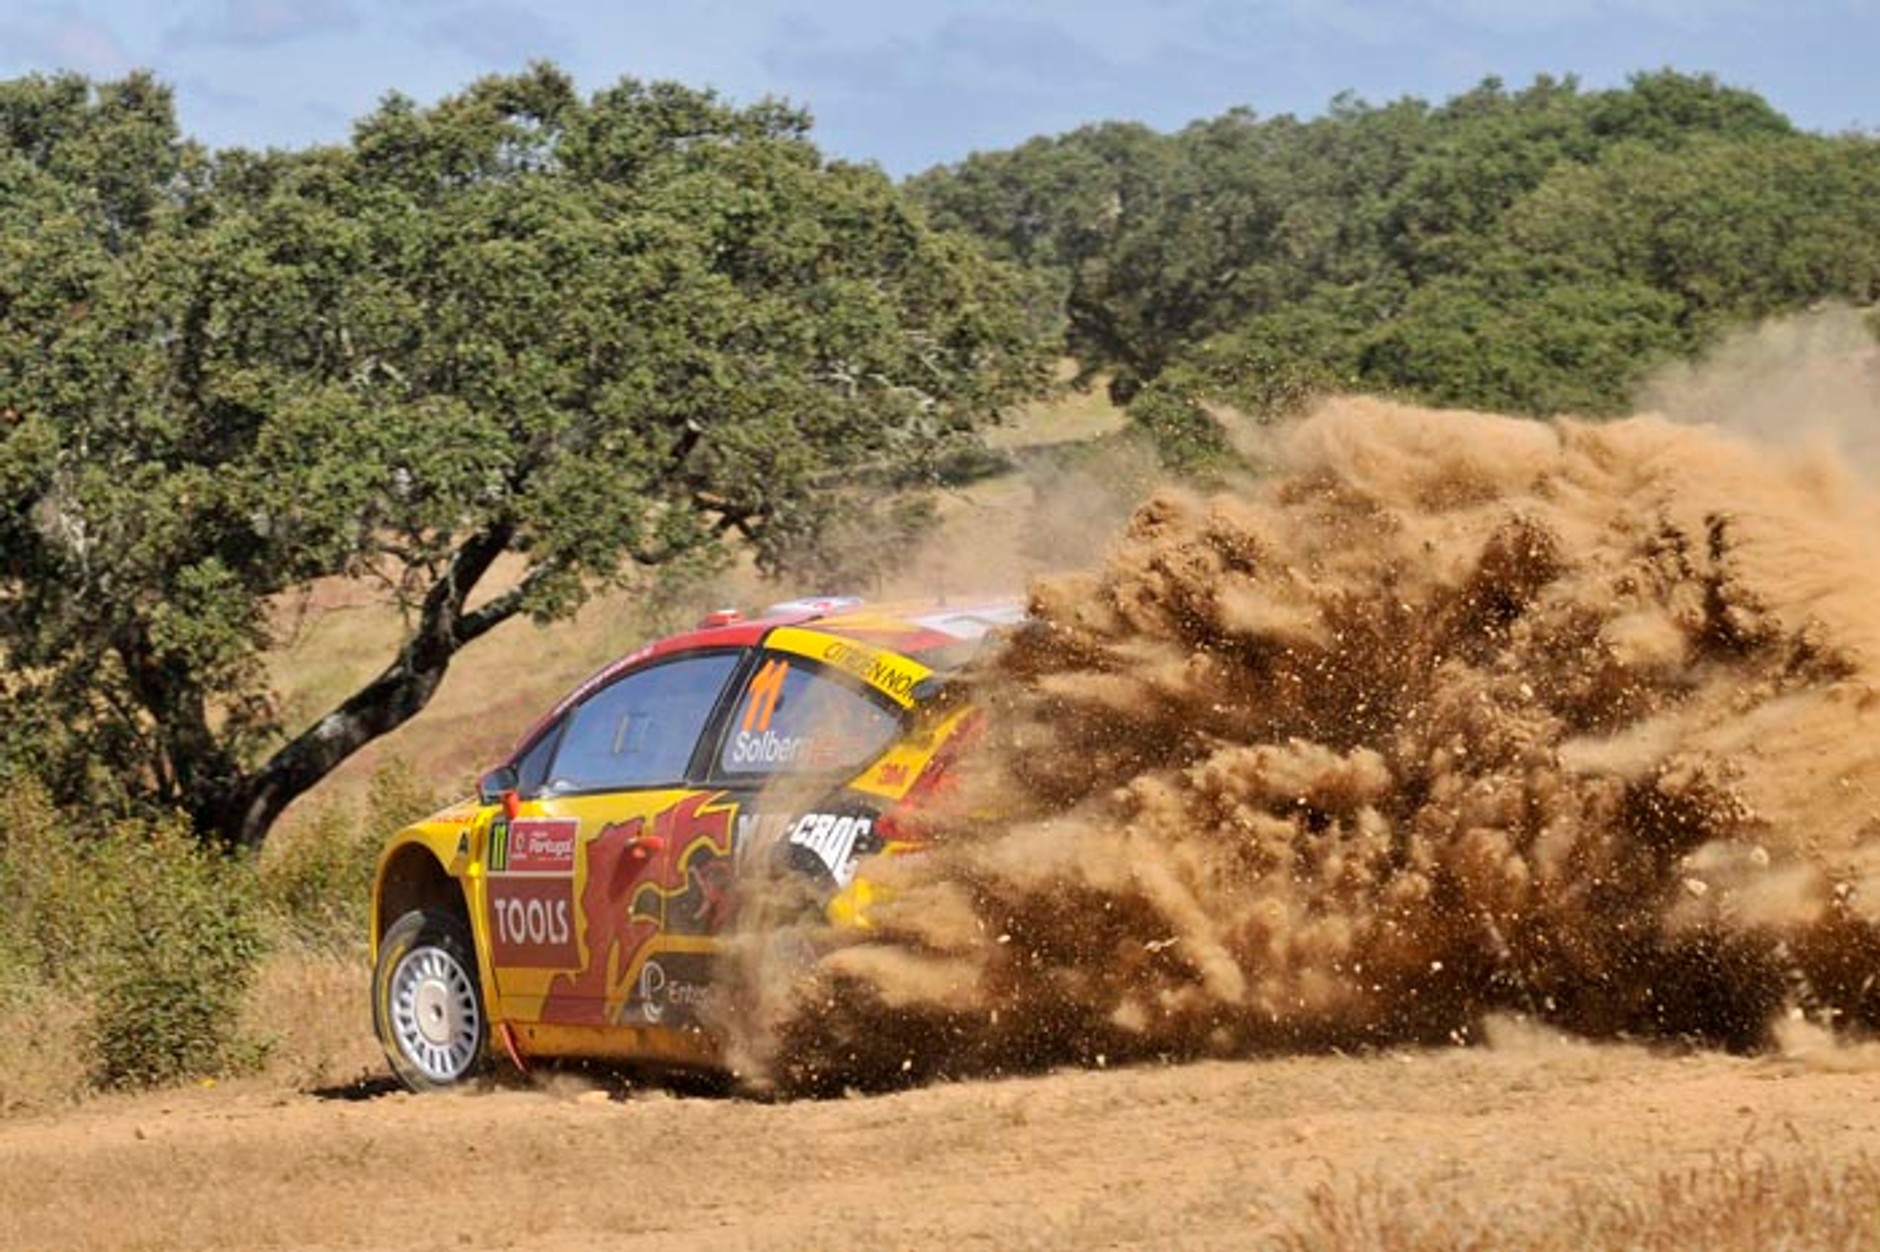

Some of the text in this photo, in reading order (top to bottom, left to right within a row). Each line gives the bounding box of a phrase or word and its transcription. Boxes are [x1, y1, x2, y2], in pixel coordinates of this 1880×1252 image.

[732, 729, 814, 763] Solber
[528, 836, 573, 858] Portugal
[493, 897, 569, 945] TOOLS
